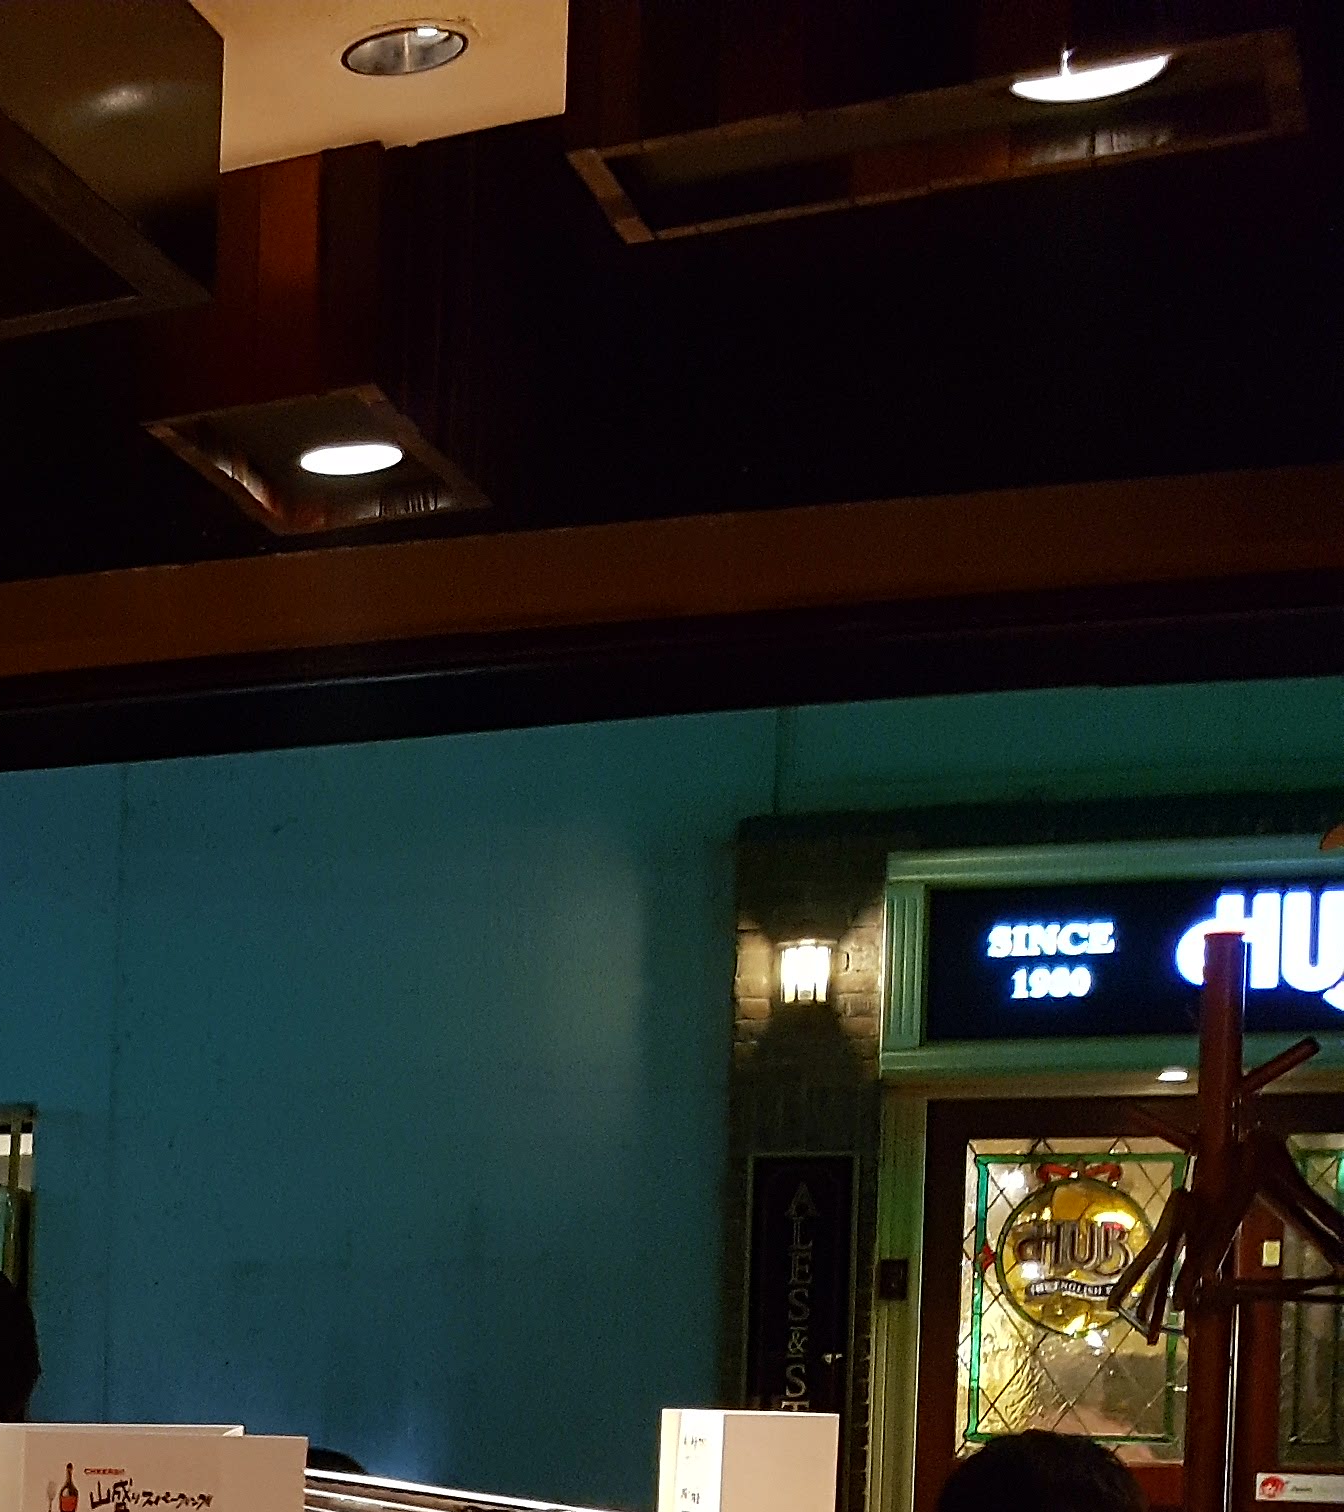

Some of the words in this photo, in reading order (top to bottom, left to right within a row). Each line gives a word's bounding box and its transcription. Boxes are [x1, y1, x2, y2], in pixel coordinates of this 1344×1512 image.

[987, 922, 1115, 957] SINCE
[1176, 890, 1344, 1012] HU
[1014, 1220, 1135, 1276] HUB
